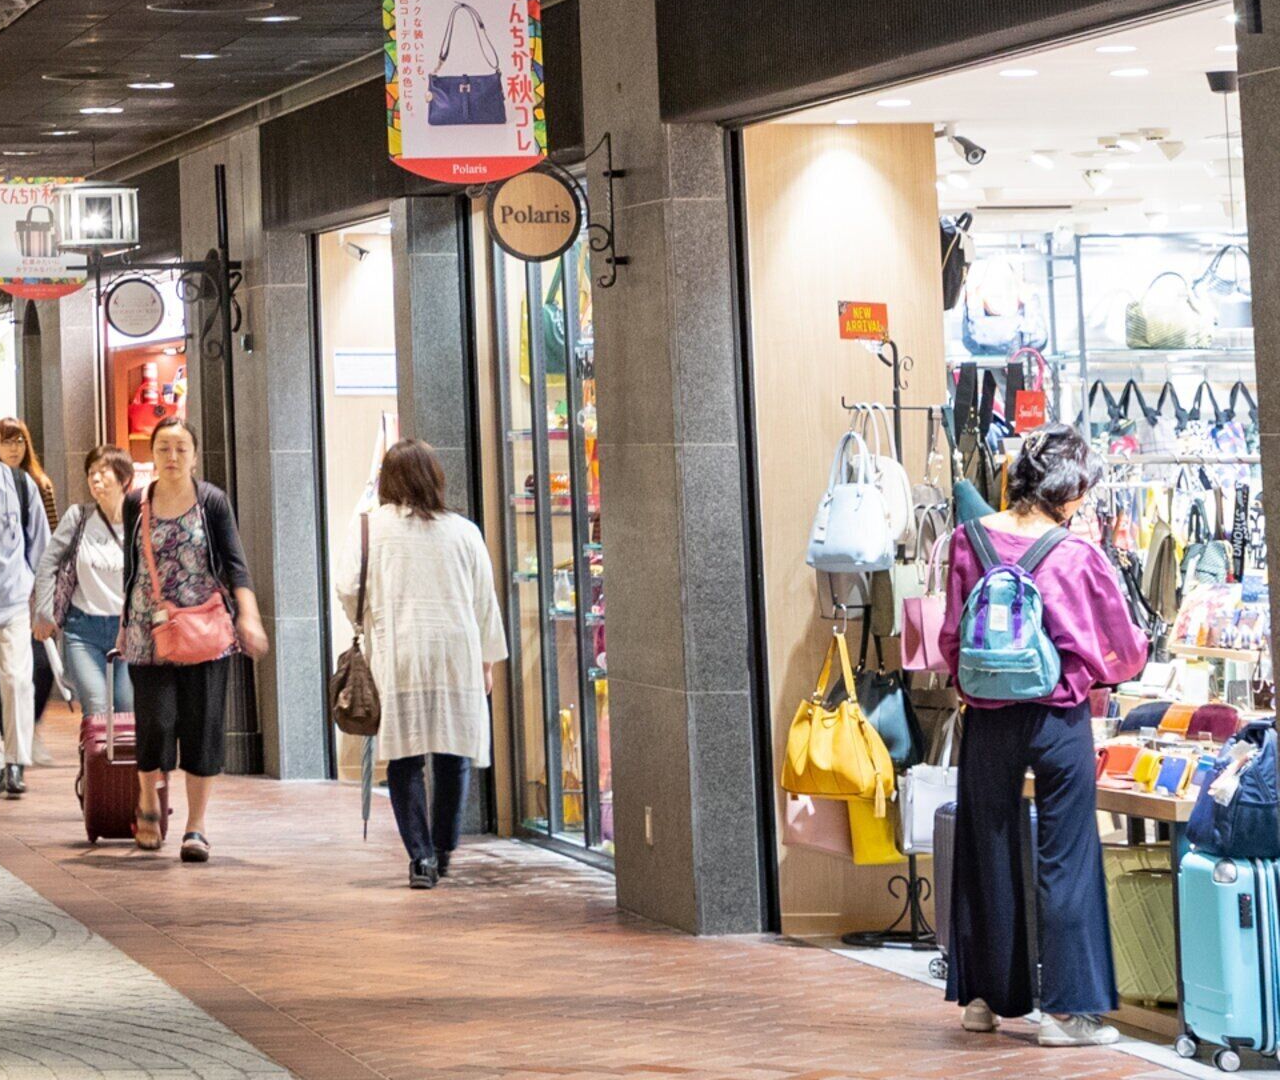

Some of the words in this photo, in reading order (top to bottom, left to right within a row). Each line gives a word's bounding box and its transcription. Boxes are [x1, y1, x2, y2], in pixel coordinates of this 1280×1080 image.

[452, 164, 488, 175] Polaris
[500, 204, 571, 224] Polaris
[852, 306, 872, 319] NEW
[845, 319, 883, 332] ARRIVAL
